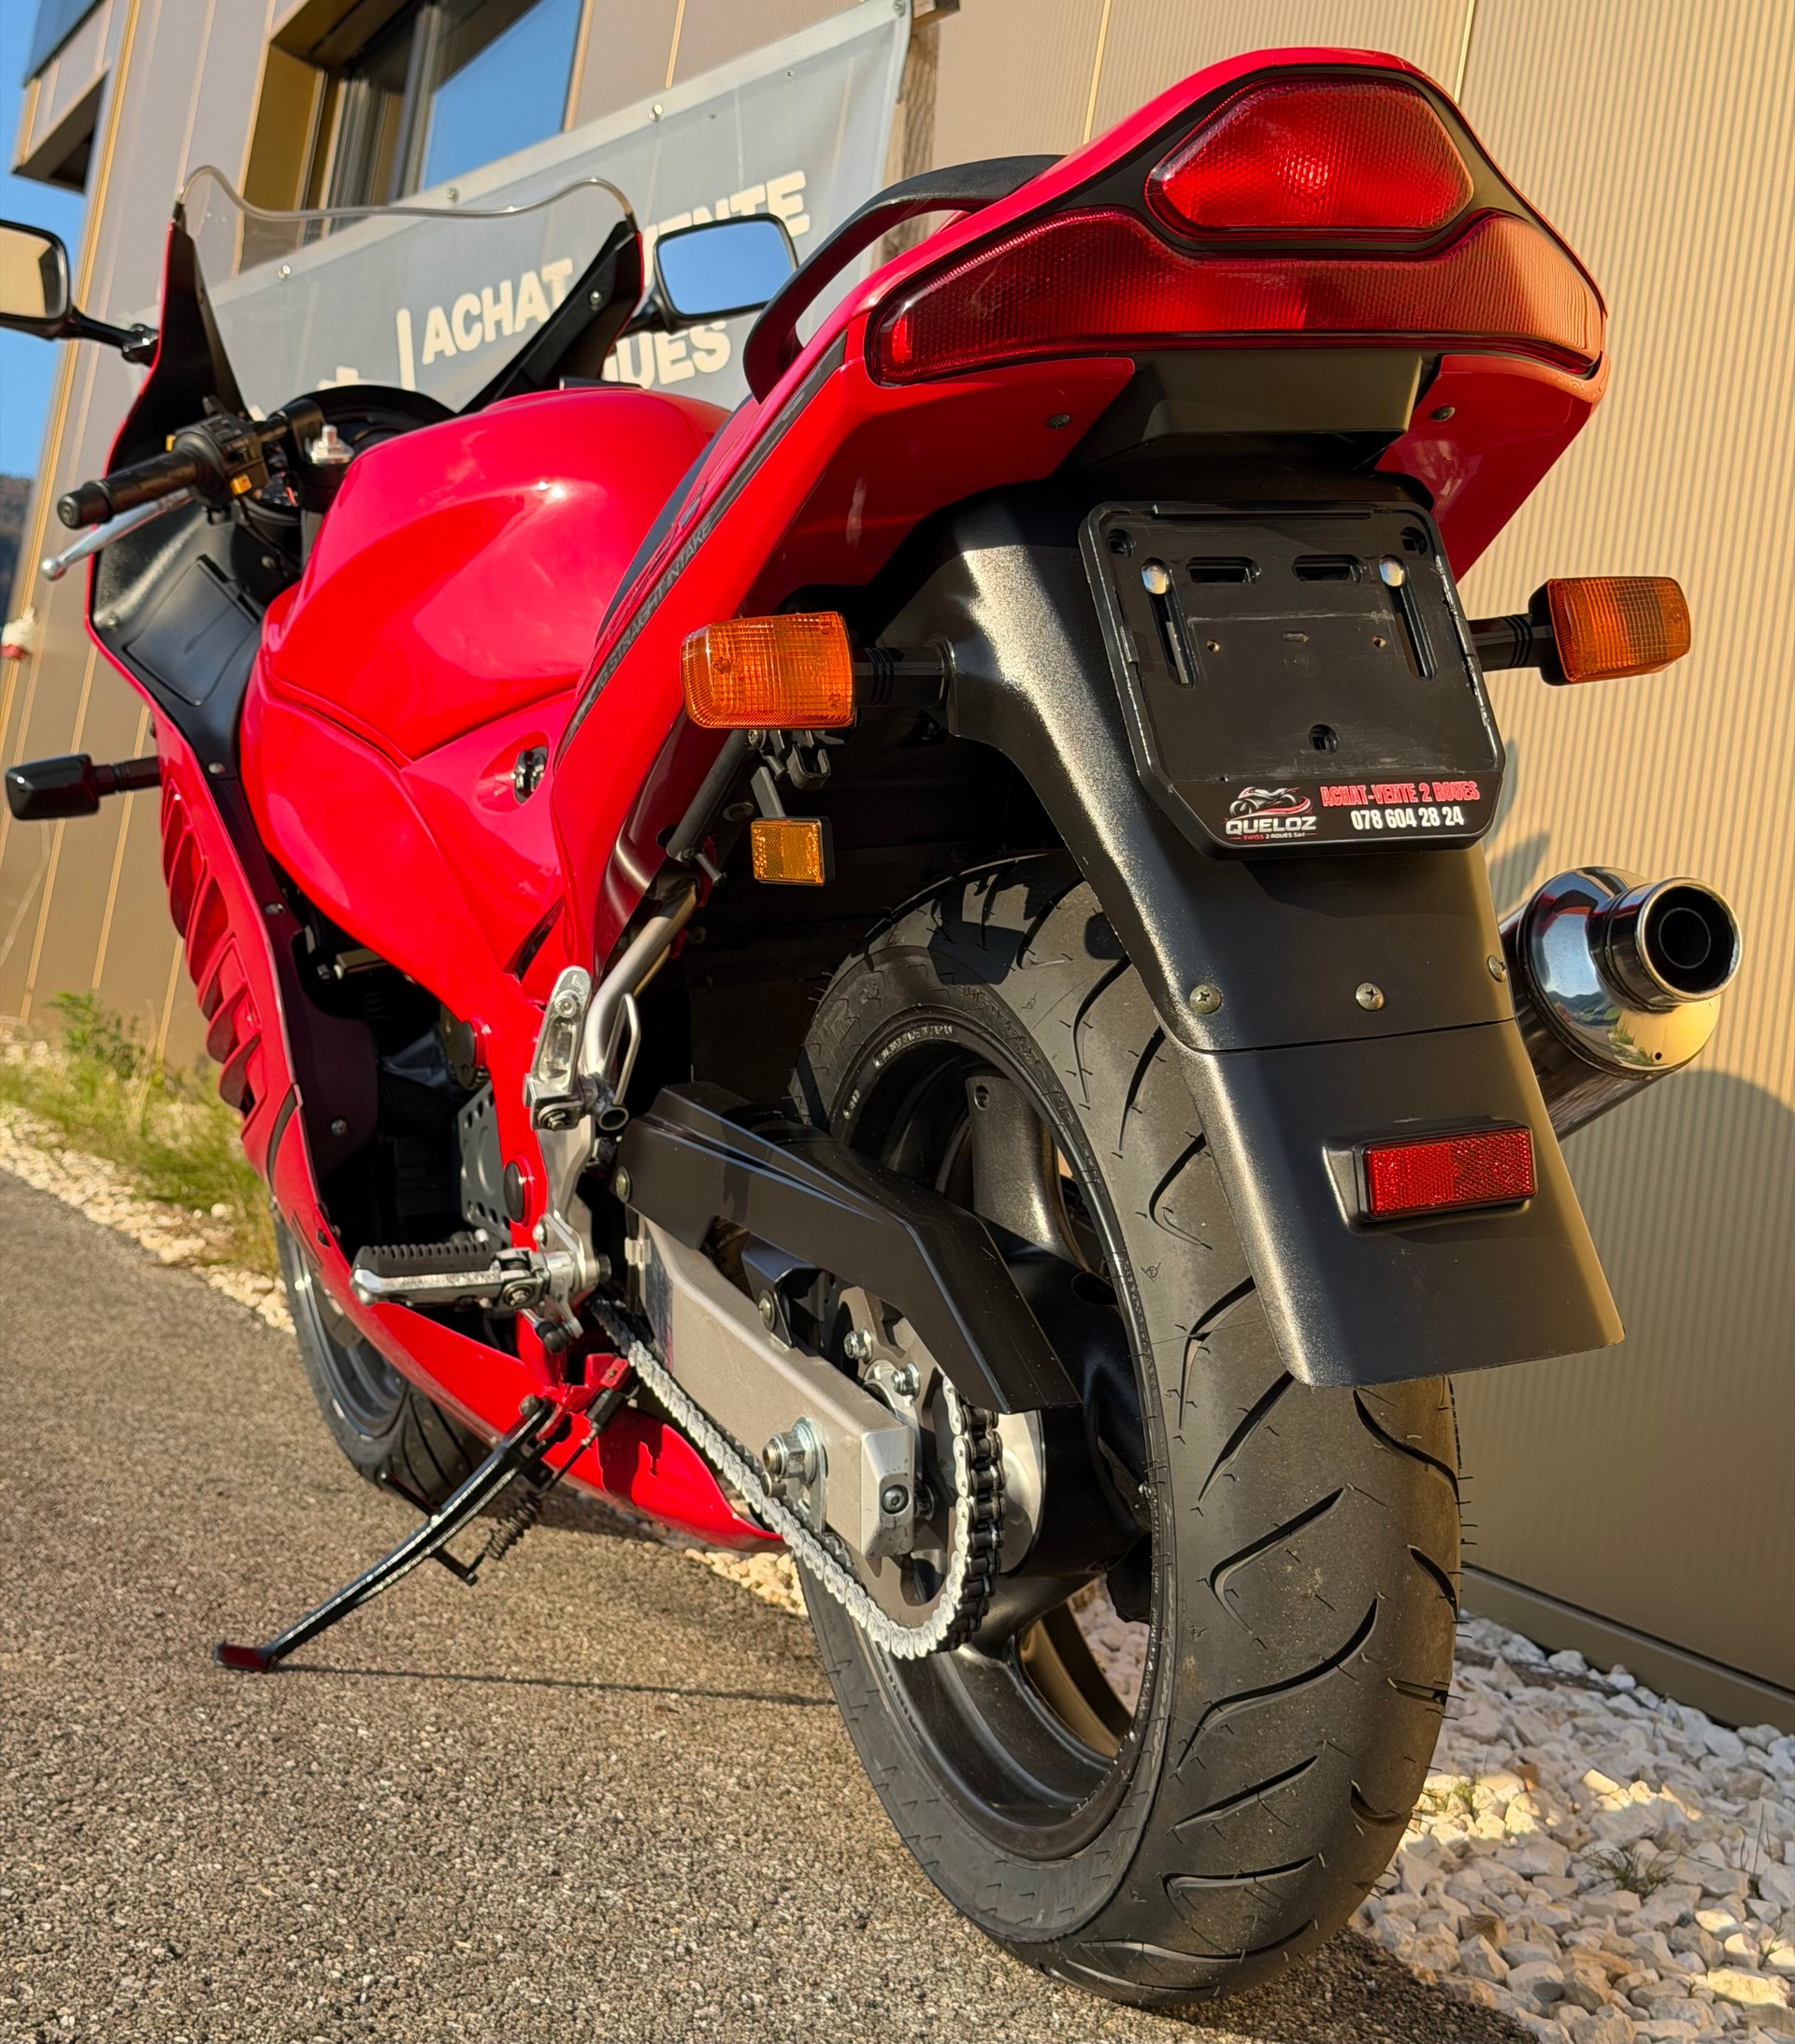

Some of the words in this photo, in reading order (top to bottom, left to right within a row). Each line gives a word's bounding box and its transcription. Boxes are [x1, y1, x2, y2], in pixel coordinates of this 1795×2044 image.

[422, 259, 573, 365] ACHAT
[1320, 783, 1419, 807] ACHAT-VENTE
[1418, 782, 1432, 802] 2
[1432, 781, 1481, 802] ROUES
[1226, 815, 1317, 835] QUELOZ
[1350, 809, 1384, 830] 078
[1385, 808, 1417, 829] 604
[1418, 806, 1441, 828] 28
[1442, 805, 1465, 827] 24
